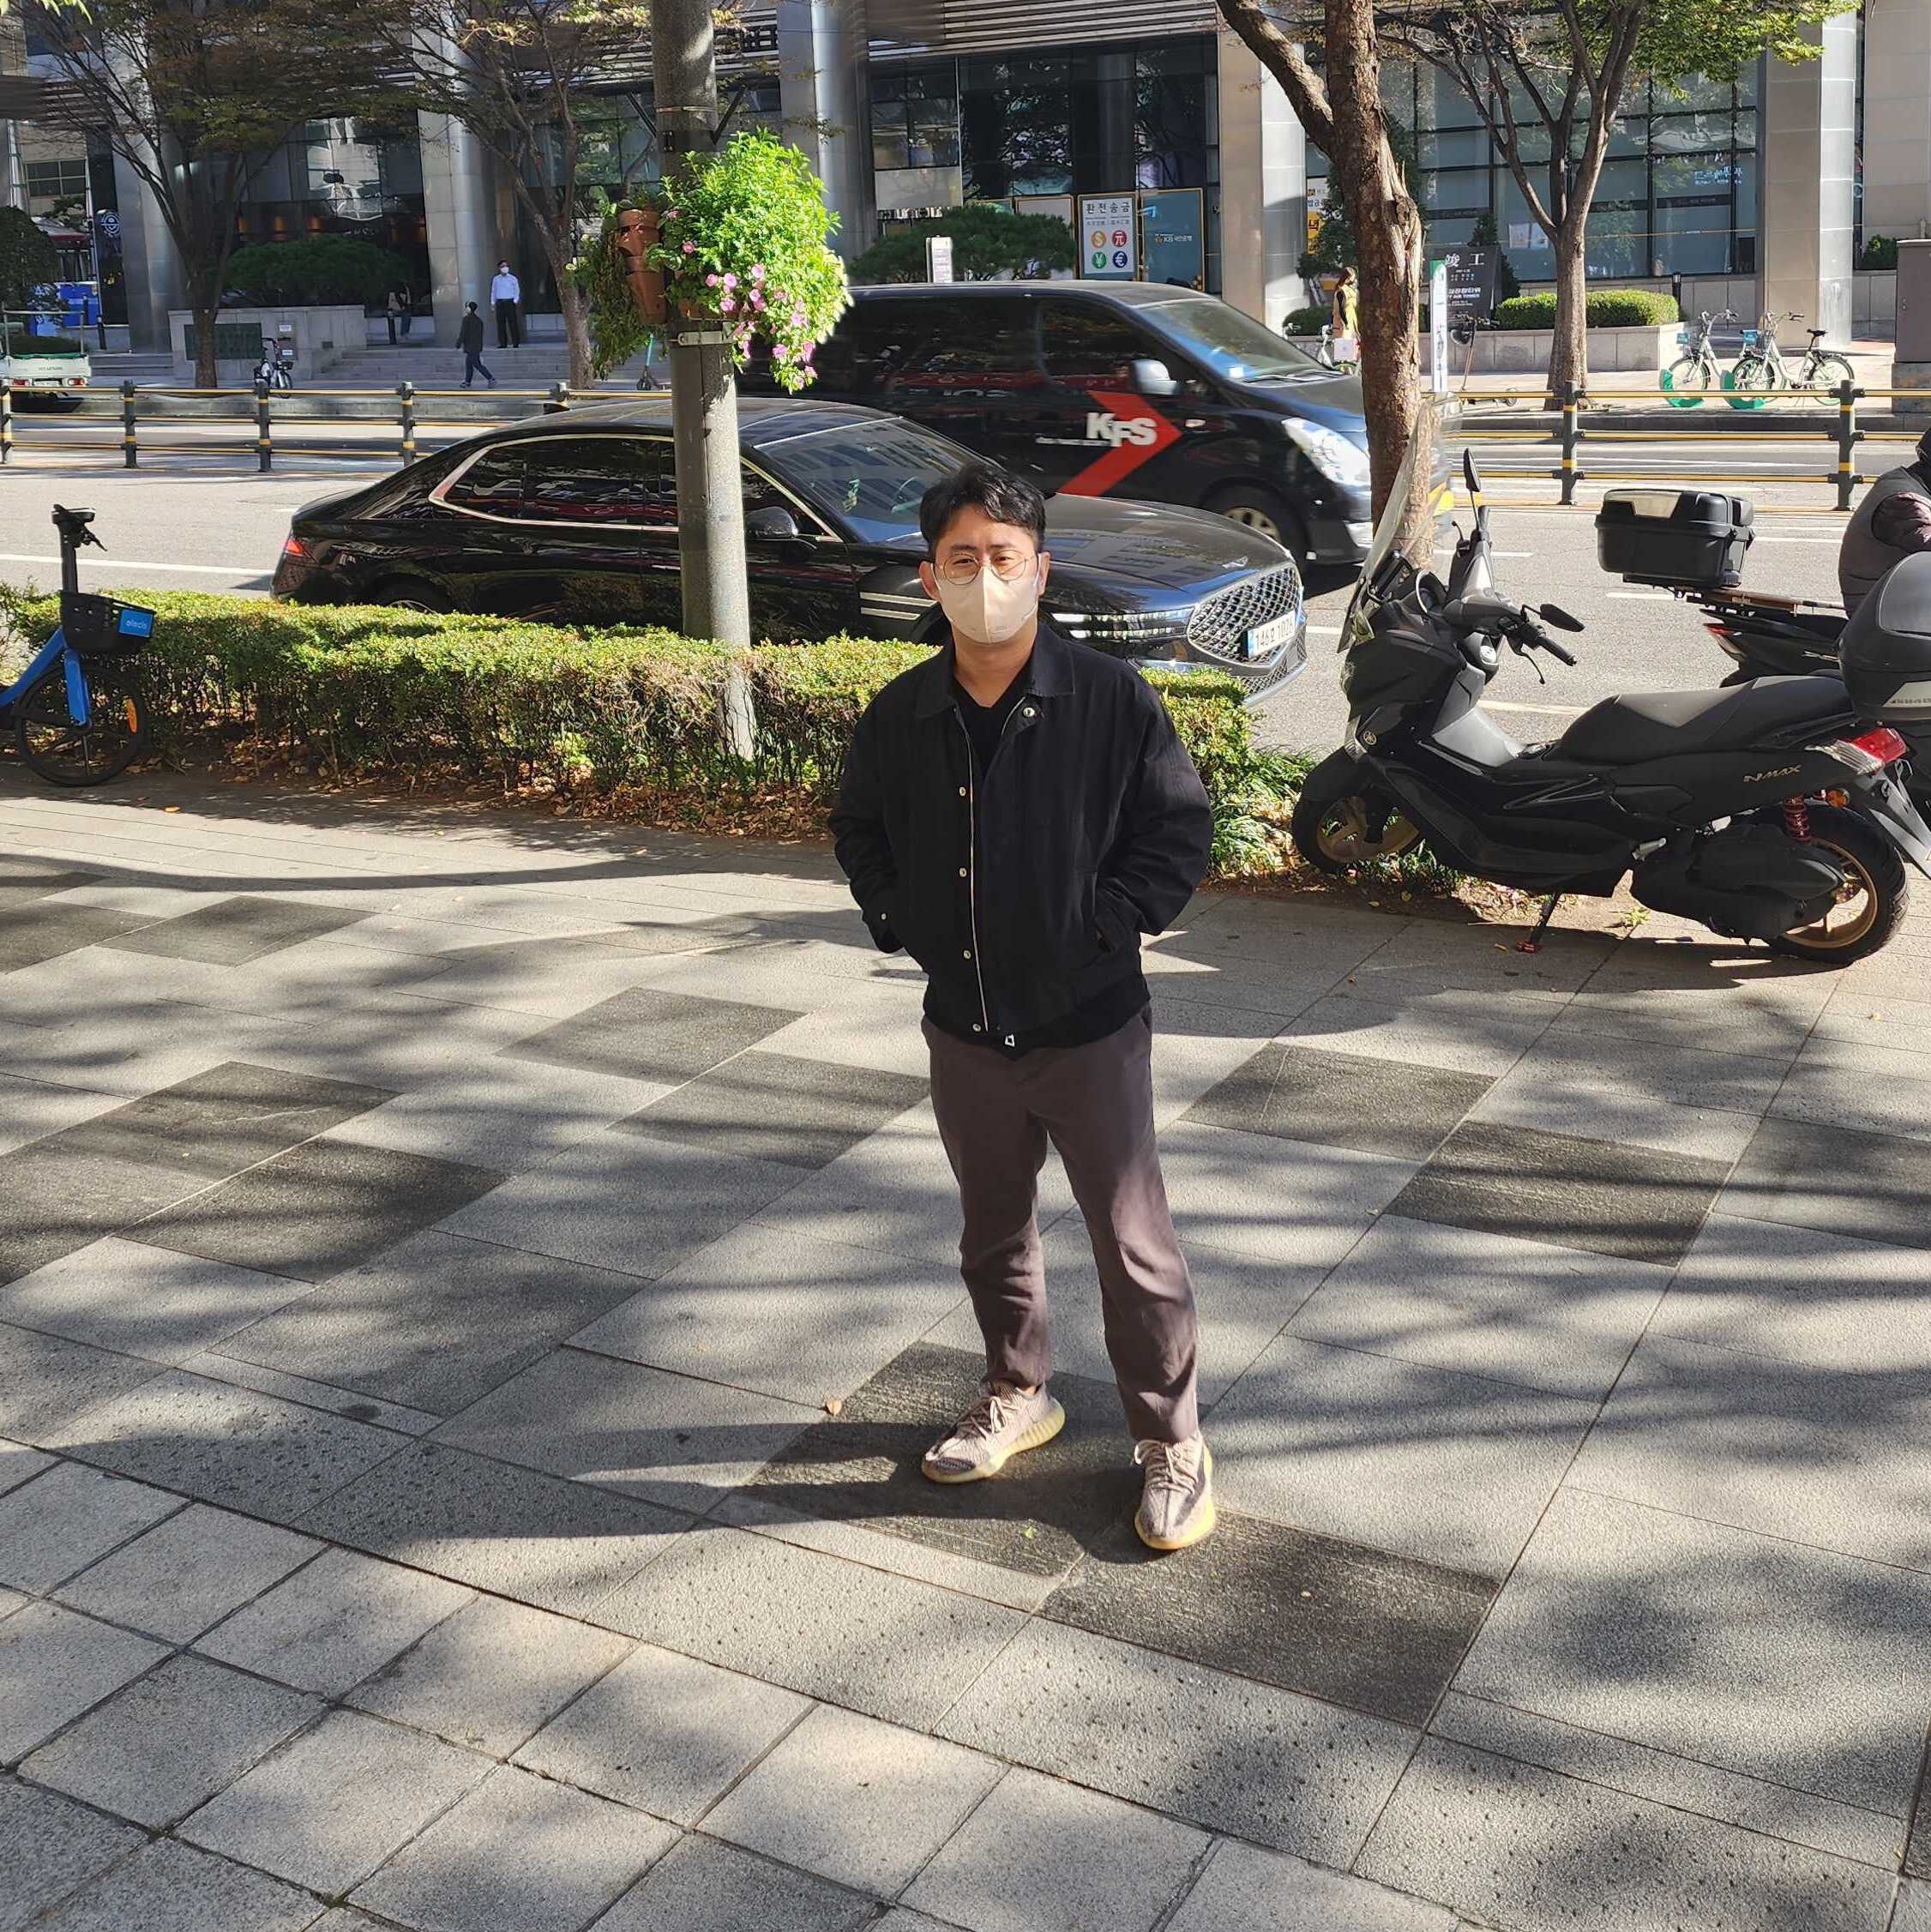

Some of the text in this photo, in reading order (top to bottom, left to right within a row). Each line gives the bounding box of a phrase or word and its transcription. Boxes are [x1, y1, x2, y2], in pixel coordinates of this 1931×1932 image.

[1086, 202, 1130, 214] 환전송금
[1086, 412, 1157, 447] KFS
[1743, 764, 1802, 782] NMAX
